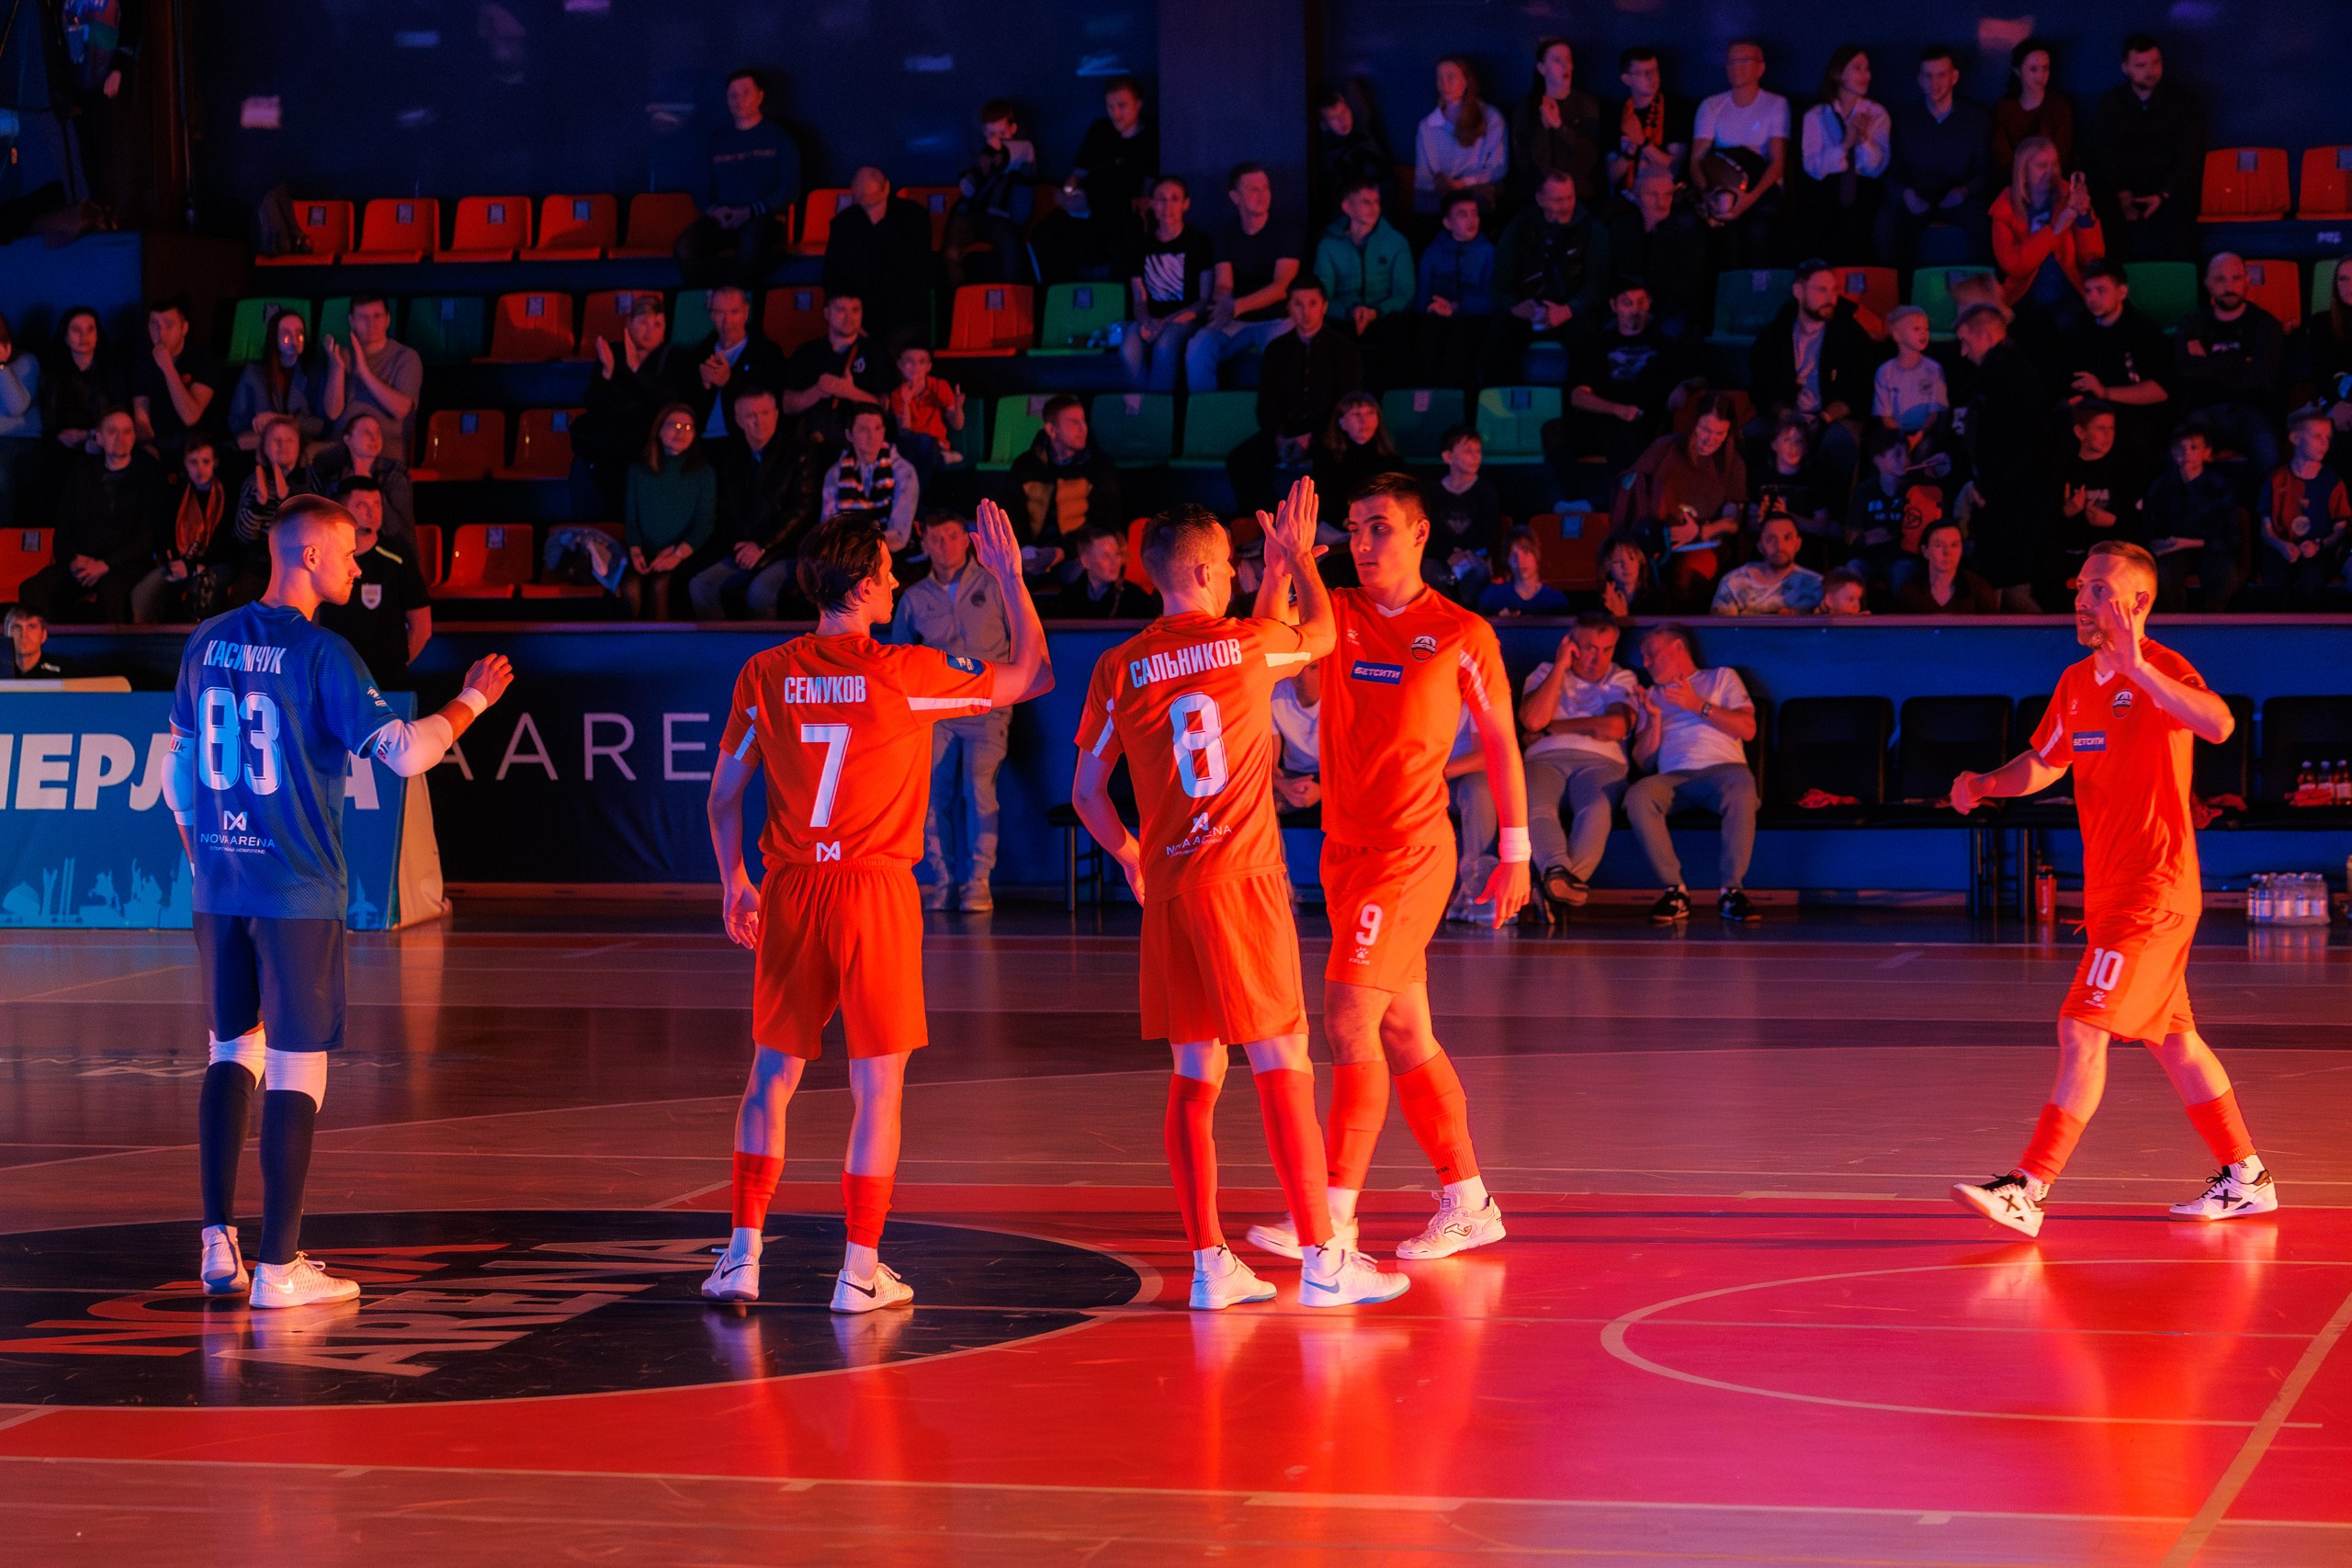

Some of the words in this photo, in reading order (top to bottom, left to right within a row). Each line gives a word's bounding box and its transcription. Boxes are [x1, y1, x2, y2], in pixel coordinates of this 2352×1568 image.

[202, 639, 288, 675] КАСИМЧУК
[1129, 638, 1242, 689] САЛЬНИКОВ
[1353, 666, 1402, 680] БЕТСИТИ
[784, 675, 866, 705] СЕМУКОВ
[198, 686, 283, 796] 83
[1169, 691, 1229, 799] 8
[800, 722, 853, 828] 7
[1354, 903, 1384, 947] 9
[2086, 947, 2125, 991] 10
